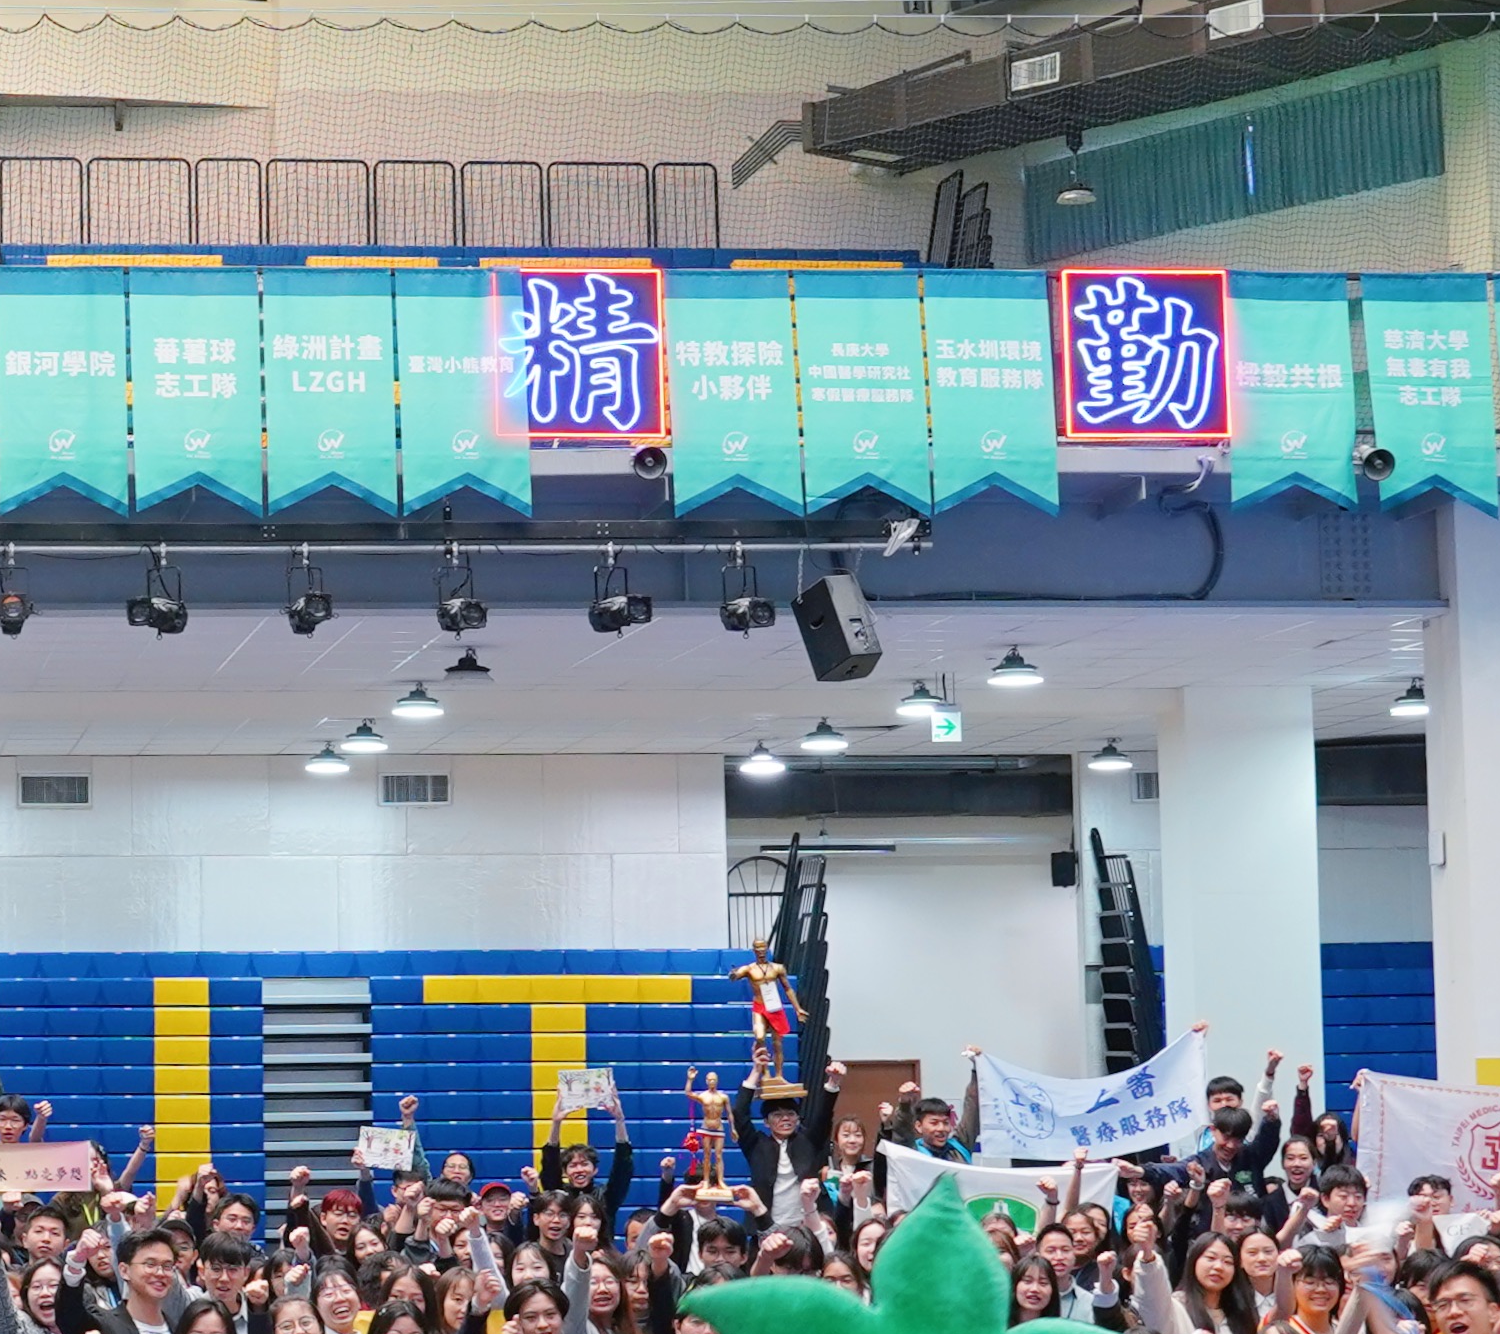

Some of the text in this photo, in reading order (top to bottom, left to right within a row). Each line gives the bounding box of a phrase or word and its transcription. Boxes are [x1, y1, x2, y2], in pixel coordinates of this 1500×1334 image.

[272, 335, 383, 362] 綠洲計畫
[499, 273, 660, 432] 精
[831, 343, 890, 358] 長庚大學
[935, 339, 1043, 362] 玉水圳環境
[1383, 329, 1470, 351] 慈濟大學
[5, 350, 116, 378] 銀河學院
[408, 354, 515, 375] 臺灣小熊教育
[675, 340, 784, 368] 特教探險
[1075, 276, 1221, 430] 勤
[936, 367, 1045, 390] 教育服務隊
[1385, 357, 1472, 379] 無毒有我
[155, 373, 239, 400] 志工隊
[292, 370, 367, 394] LZGH
[691, 374, 773, 401] 小夥伴
[1398, 385, 1462, 407] 志工隊
[1070, 1096, 1193, 1147] 醫療服務隊
